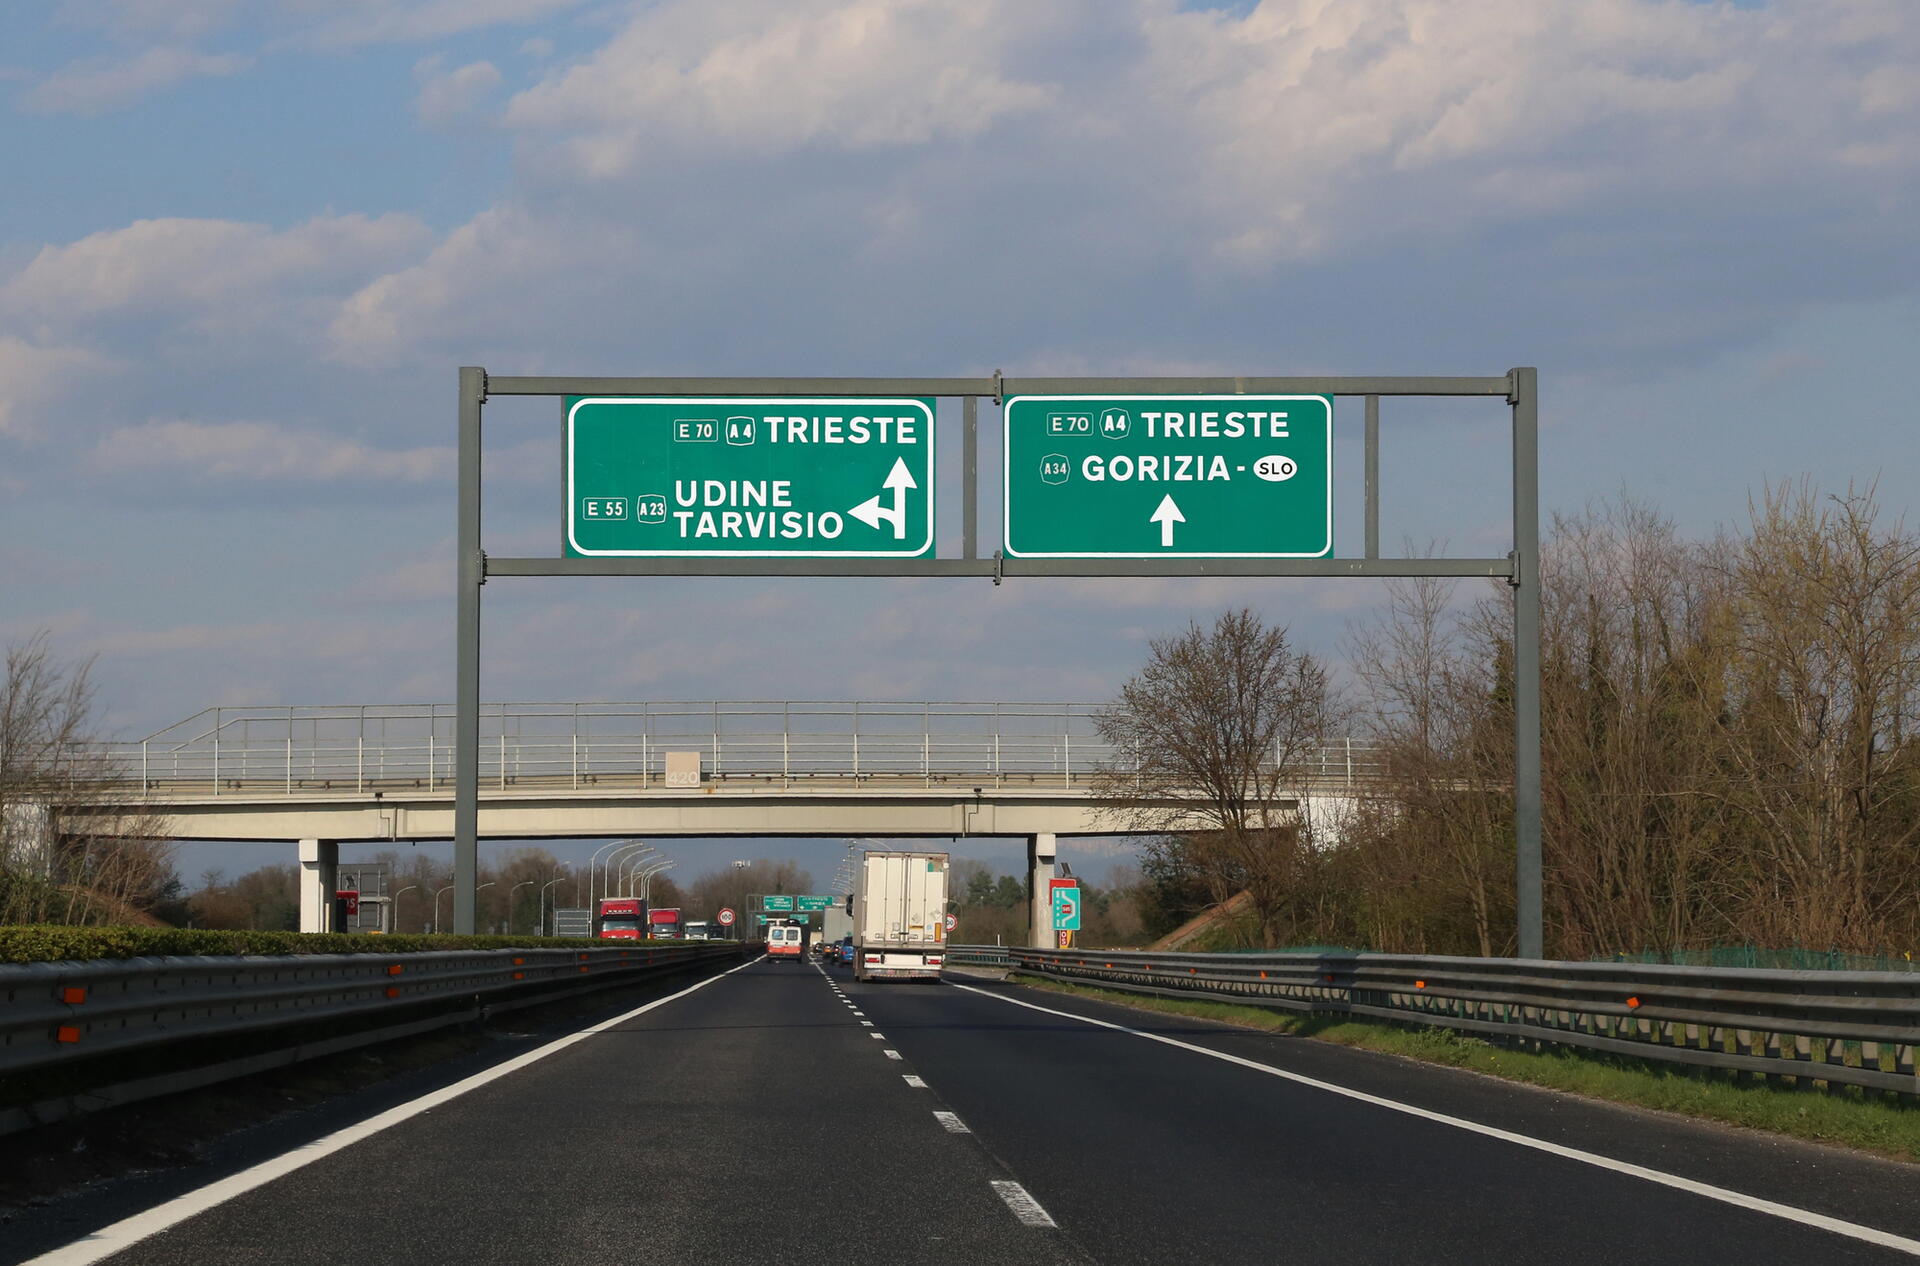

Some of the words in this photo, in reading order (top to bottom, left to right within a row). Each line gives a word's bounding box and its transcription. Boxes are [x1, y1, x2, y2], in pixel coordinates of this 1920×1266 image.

[679, 424, 690, 437] E
[696, 424, 712, 437] 70
[764, 417, 916, 444] TRIESTE
[1052, 418, 1062, 431] E
[1067, 418, 1089, 431] 70
[1104, 417, 1126, 431] A4
[1141, 412, 1289, 438] TRIESTE
[1045, 462, 1066, 475] A34
[1082, 455, 1230, 481] GORIZIA
[1259, 463, 1293, 475] SLO
[675, 480, 792, 507] UDINE
[588, 502, 598, 515] E
[605, 502, 623, 515] 55
[640, 502, 664, 516] A23
[673, 512, 844, 539] TARVISIO
[669, 771, 697, 784] 420
